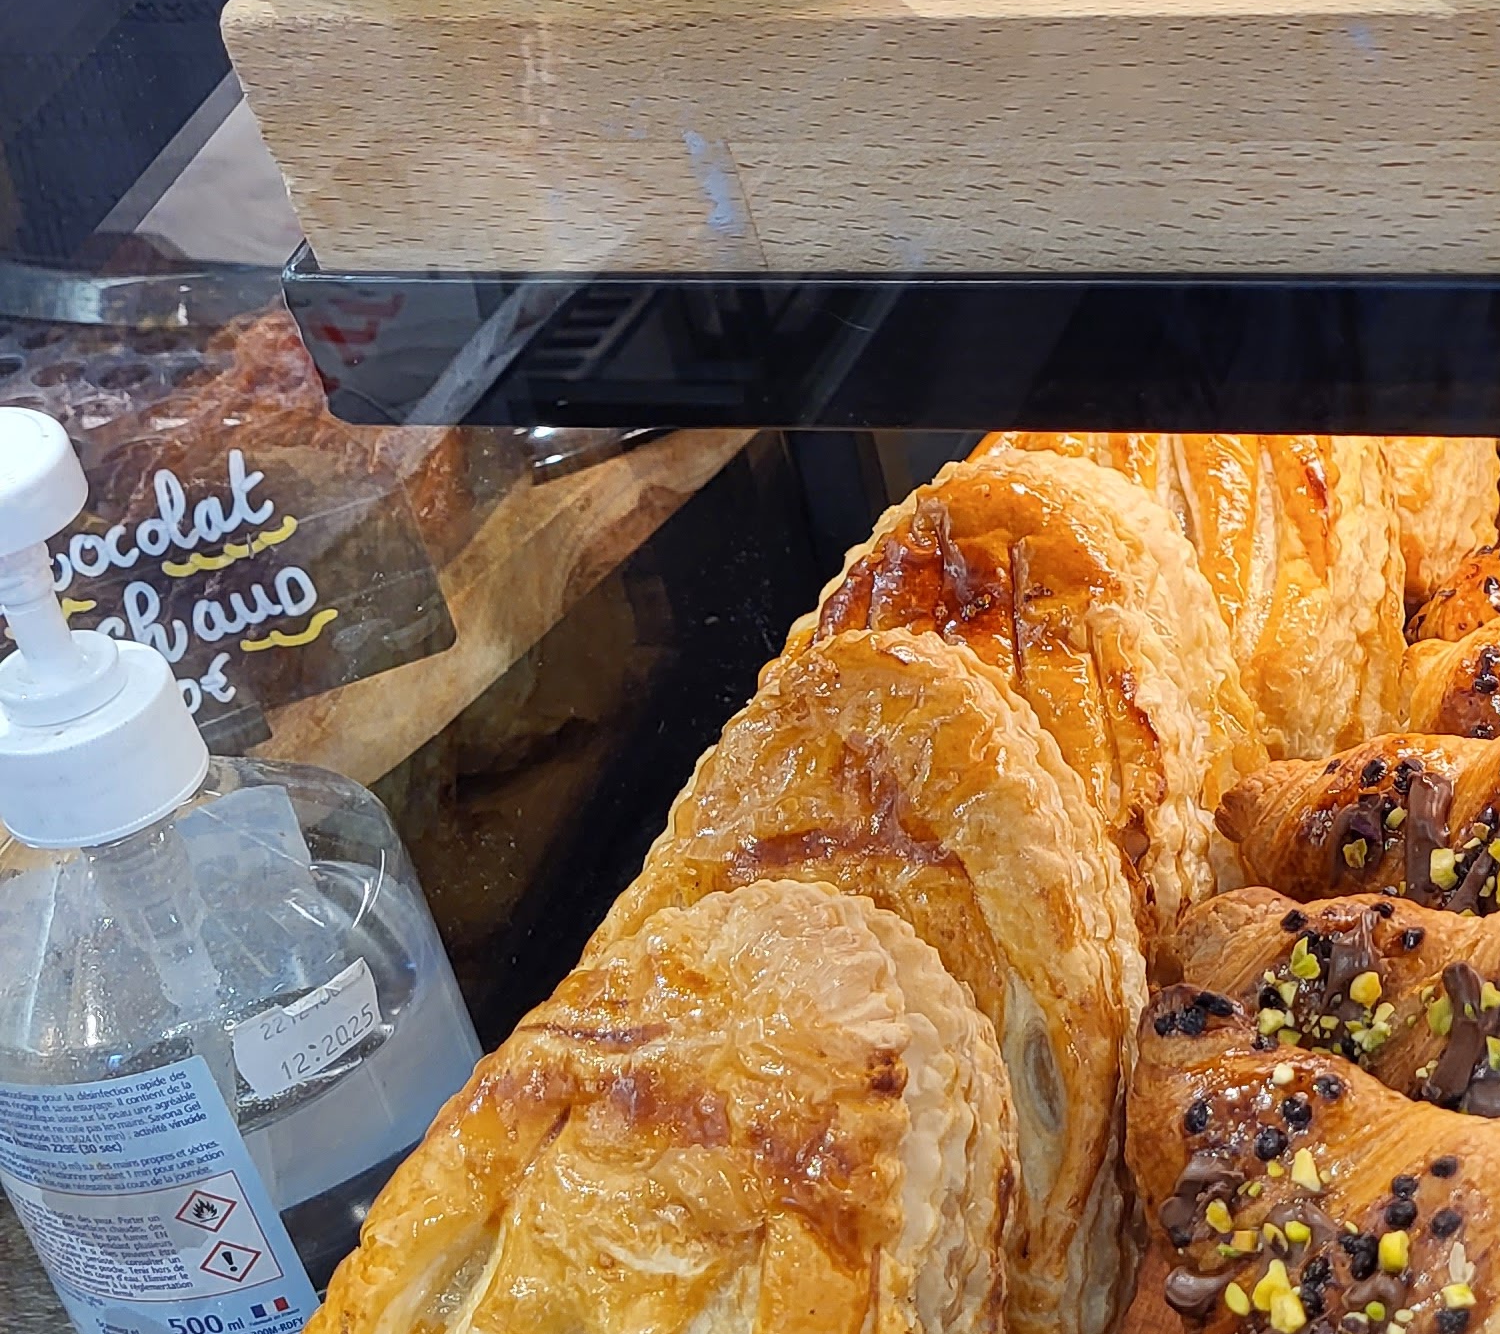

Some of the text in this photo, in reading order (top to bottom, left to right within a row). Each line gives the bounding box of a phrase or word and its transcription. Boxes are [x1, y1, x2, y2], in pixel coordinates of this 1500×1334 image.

[136, 1077, 167, 1091] rapide
[169, 1071, 187, 1082] des
[125, 1090, 166, 1105] contient
[167, 1084, 180, 1095] de
[181, 1080, 192, 1089] la
[154, 1091, 197, 1111] agréable
[148, 1108, 183, 1123] Savona
[183, 1101, 201, 1113] Gel
[133, 1123, 168, 1138] activité
[140, 1152, 176, 1167] propres
[196, 1149, 225, 1165] action
[227, 1317, 245, 1332] ml
